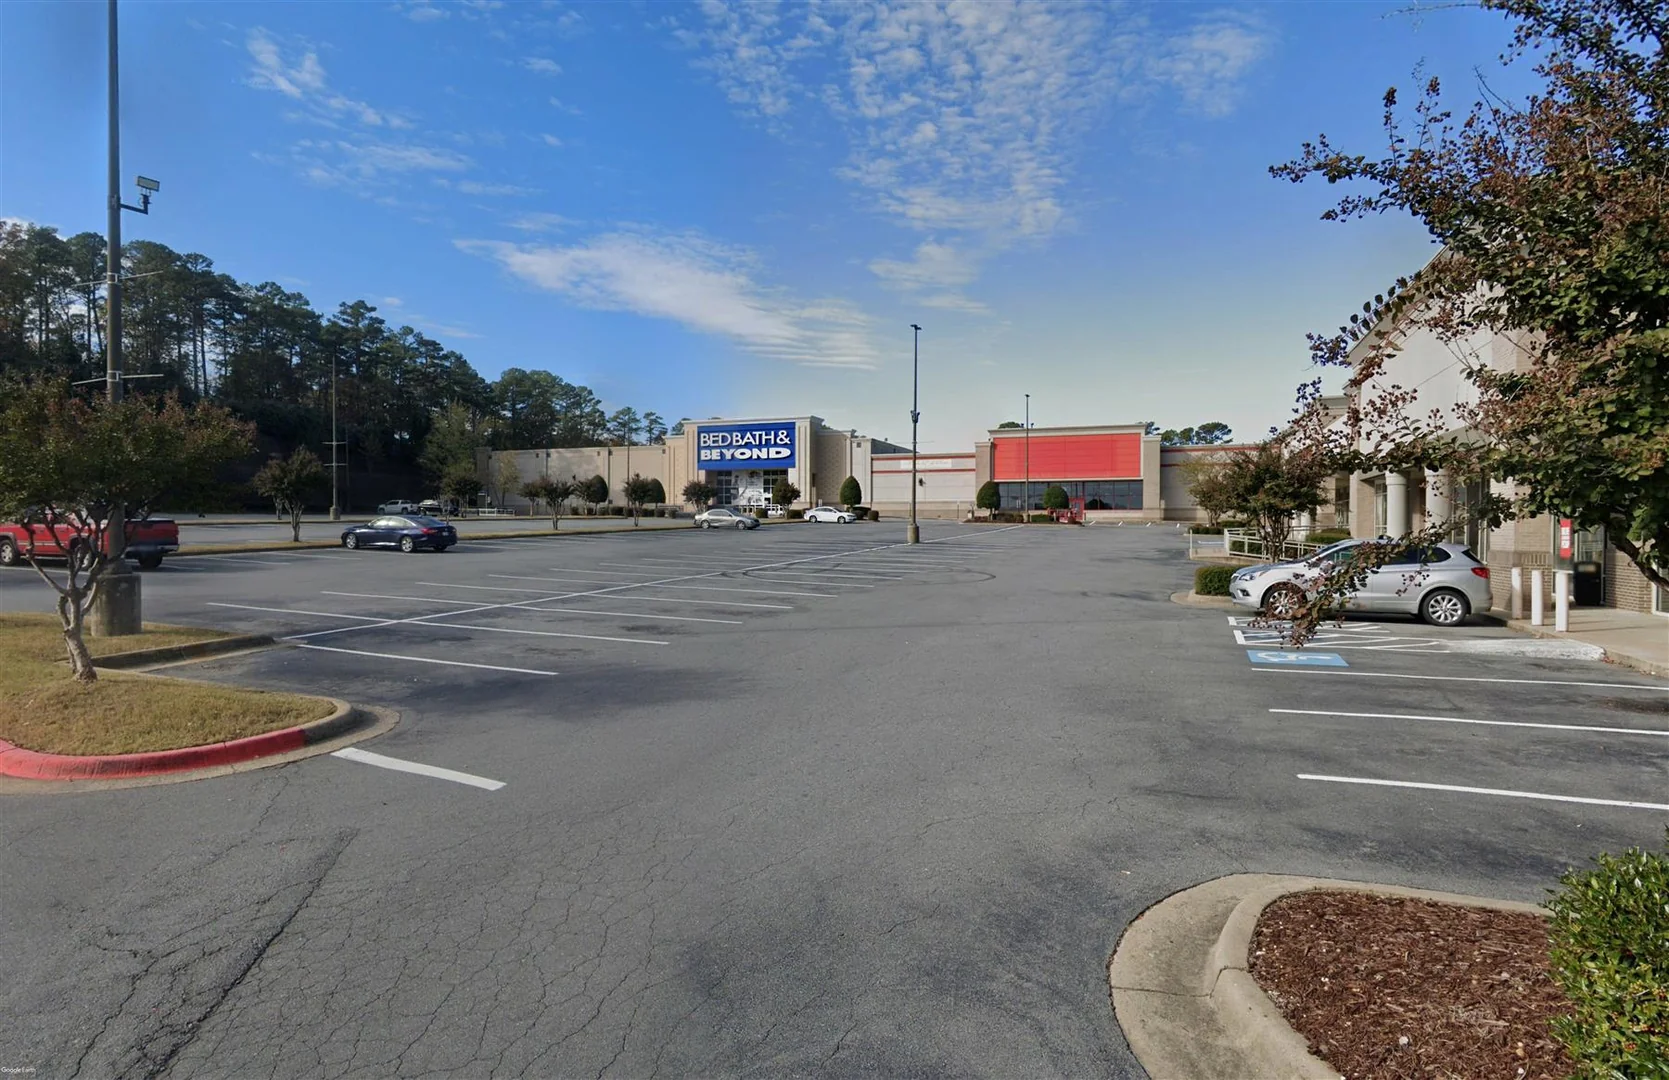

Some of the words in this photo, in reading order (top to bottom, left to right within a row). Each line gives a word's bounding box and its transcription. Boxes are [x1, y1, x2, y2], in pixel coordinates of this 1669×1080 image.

[700, 432, 731, 447] BED
[733, 431, 775, 446] BATH
[776, 430, 791, 444] &
[700, 447, 791, 461] BEYOND
